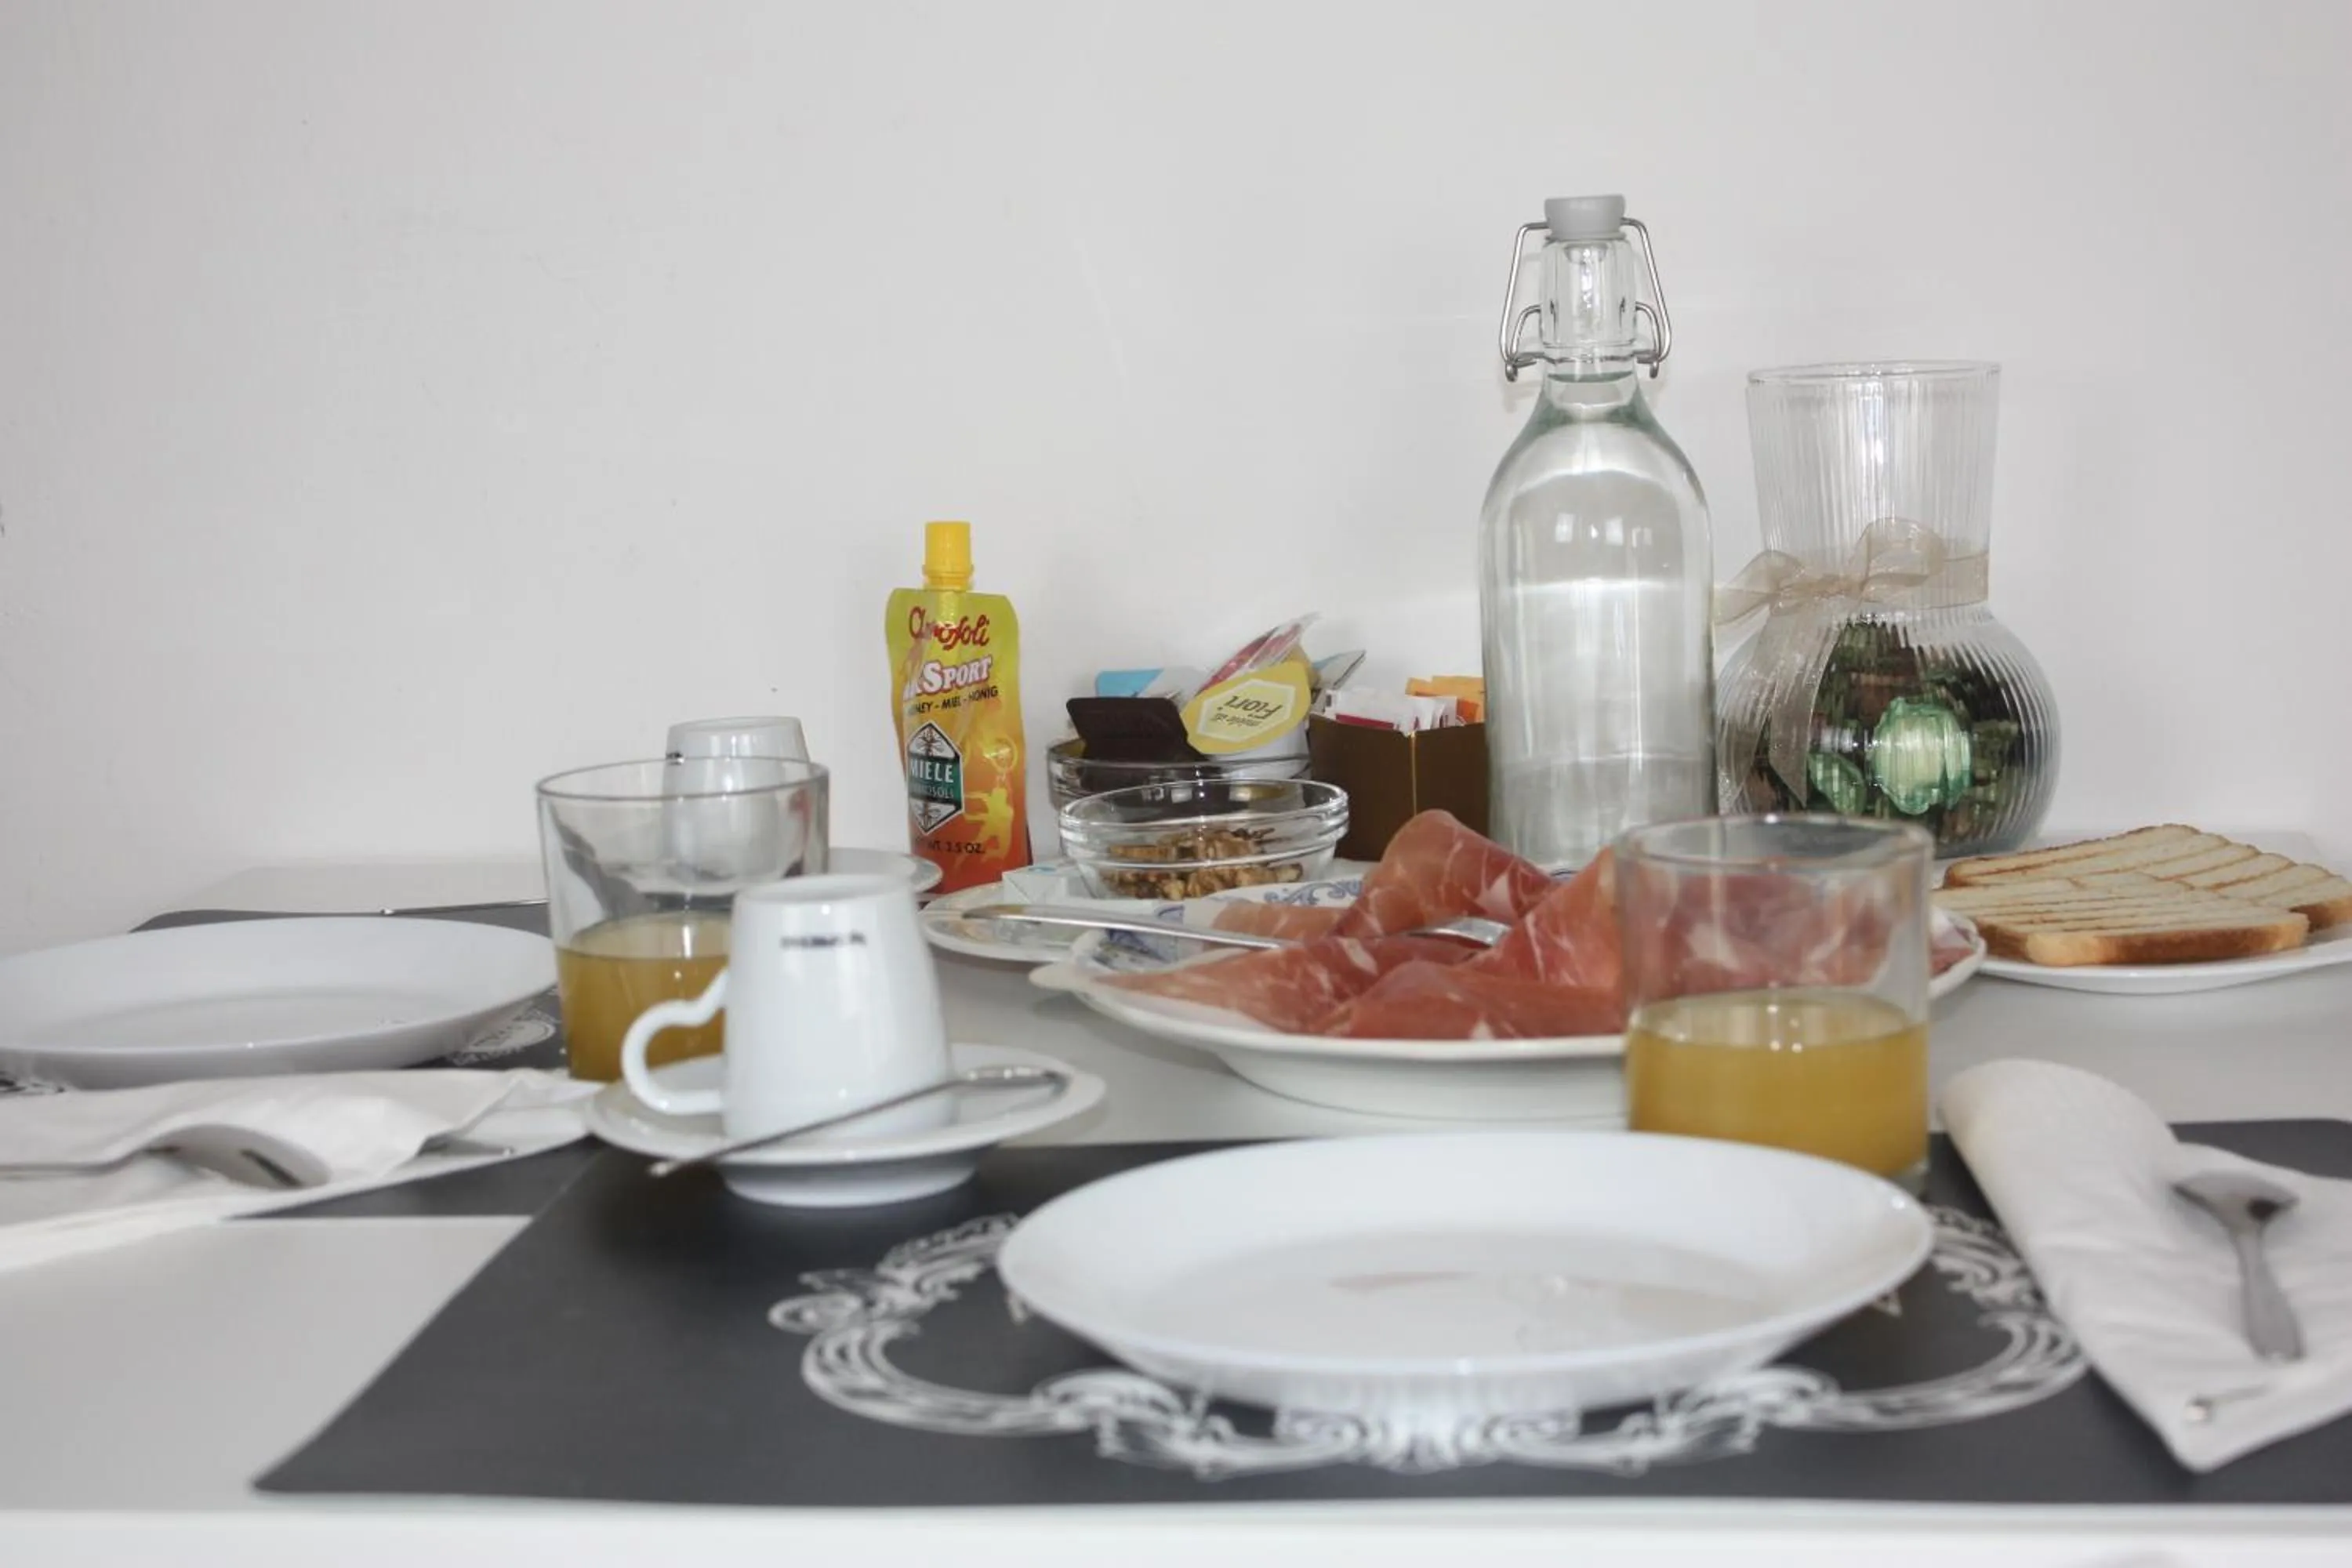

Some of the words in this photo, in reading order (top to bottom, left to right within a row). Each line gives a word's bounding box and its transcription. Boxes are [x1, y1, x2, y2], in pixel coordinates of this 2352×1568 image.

[968, 684, 999, 702] HONIG
[1218, 695, 1283, 720] Fiori
[910, 758, 954, 783] MIELE
